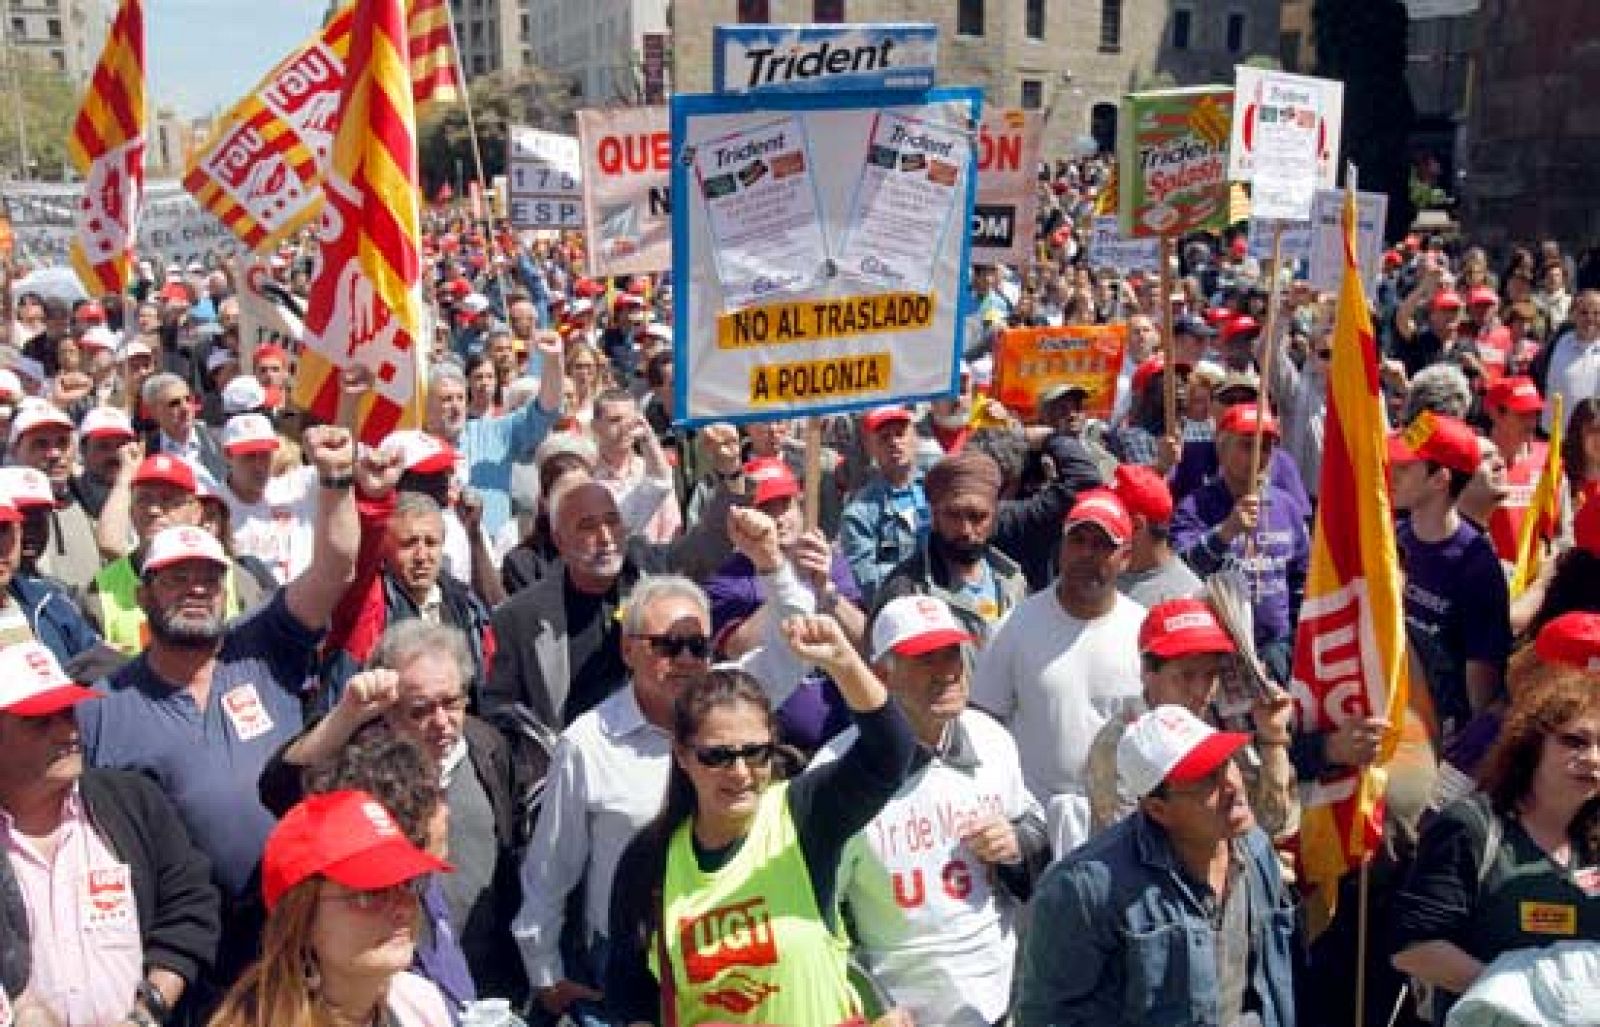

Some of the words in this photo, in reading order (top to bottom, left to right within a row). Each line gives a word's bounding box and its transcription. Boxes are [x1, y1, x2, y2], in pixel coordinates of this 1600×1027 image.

[745, 38, 895, 88] Trident
[732, 312, 768, 344] NO
[776, 308, 806, 339] AL
[814, 297, 930, 334] TRASLADO
[753, 371, 770, 399] A
[778, 363, 879, 397] POLONIA
[692, 905, 772, 955] UGT
